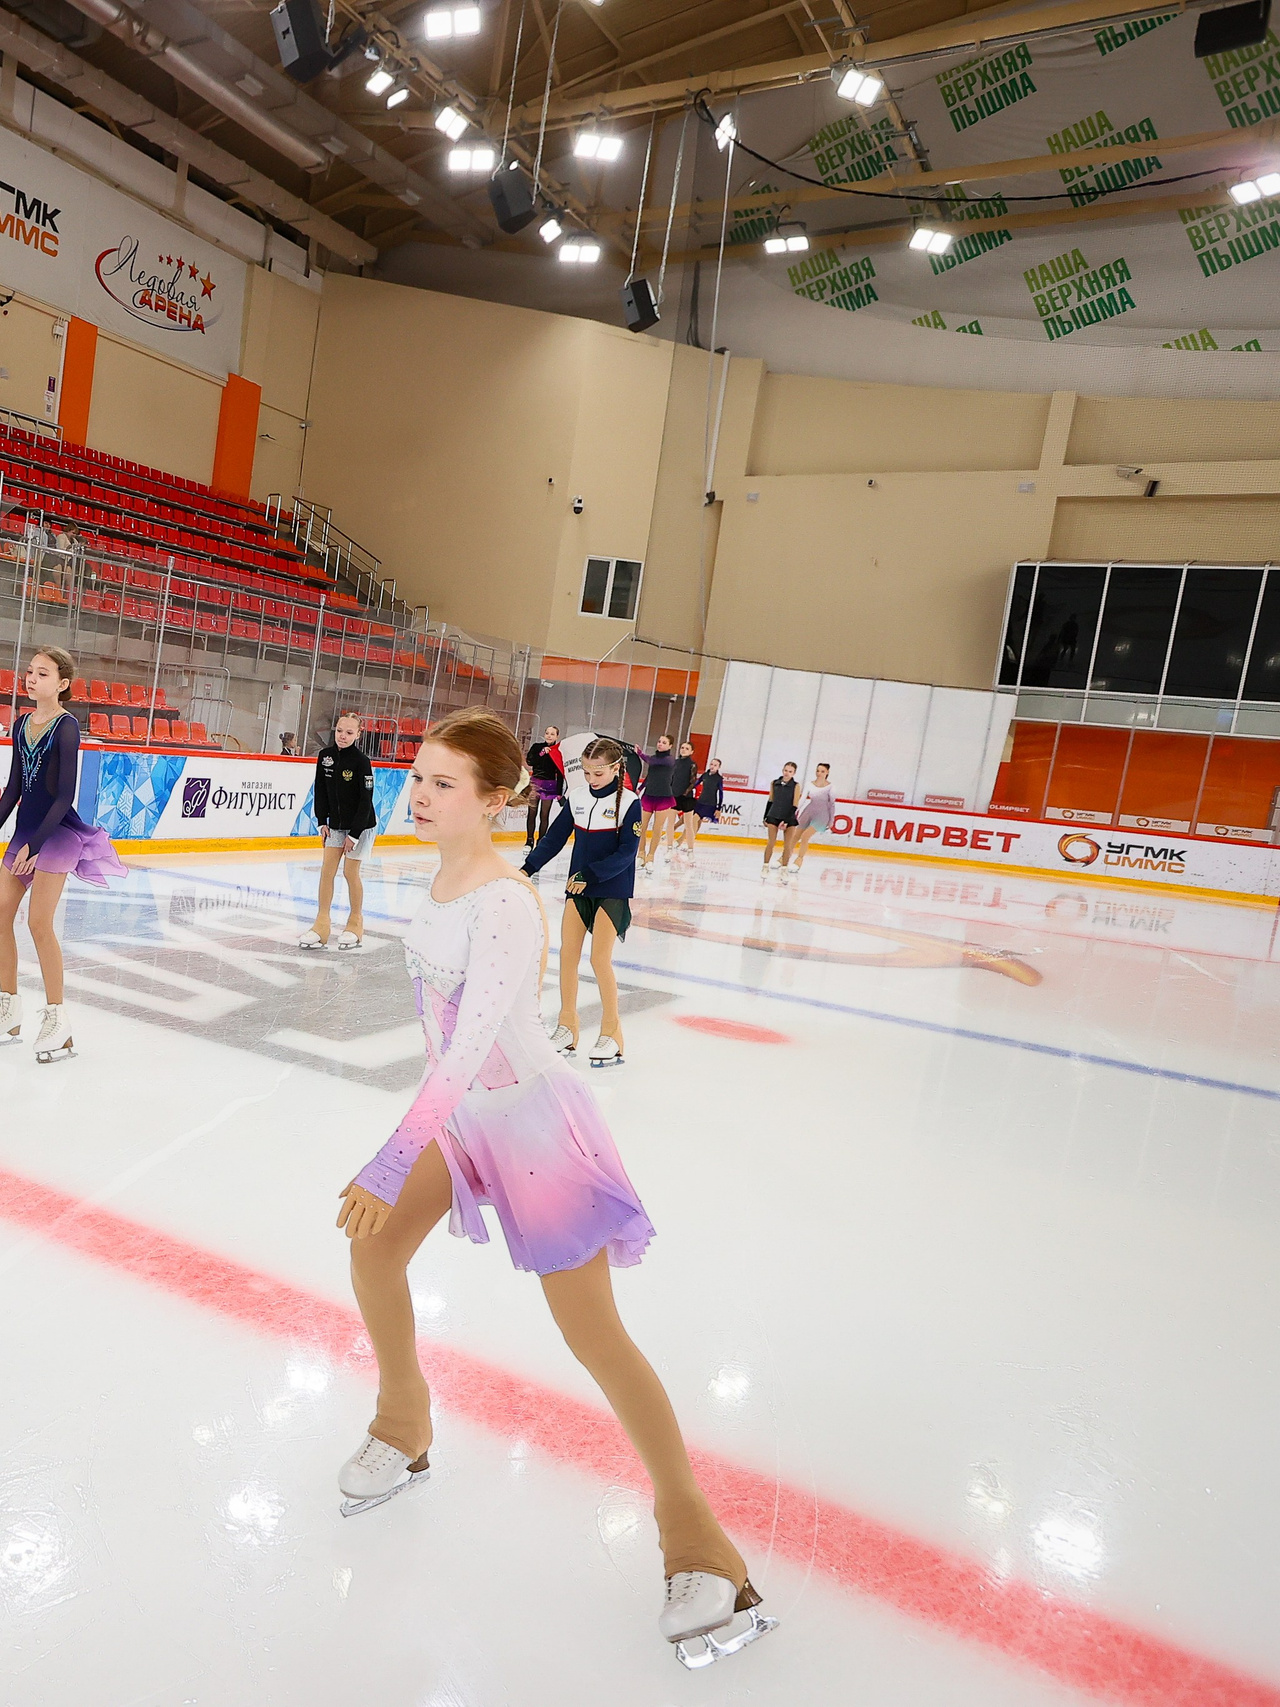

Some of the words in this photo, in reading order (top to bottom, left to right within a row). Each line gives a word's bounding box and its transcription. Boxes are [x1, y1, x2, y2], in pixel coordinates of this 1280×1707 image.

[1093, 12, 1183, 57] ПЫШ
[940, 42, 1033, 108] ВЕРХНЯЯ
[949, 71, 1037, 133] ПЫШМА
[1046, 110, 1114, 155] НАША
[787, 248, 841, 287] НАША
[1023, 248, 1089, 293] НАША
[1032, 257, 1132, 317] ВЕРХНЯЯ
[139, 289, 205, 335] АРЕНА
[1042, 287, 1136, 341] ПЫШМА
[211, 786, 296, 816] Фигурист
[241, 781, 273, 790] магазин
[868, 790, 905, 800] OLIMPBET
[925, 796, 964, 807] OLIMPBET
[989, 804, 1030, 813] OLIMPBET
[830, 814, 1021, 853] OLIMPBET
[1106, 842, 1188, 862] УГМК
[1104, 854, 1186, 874] UMMC
